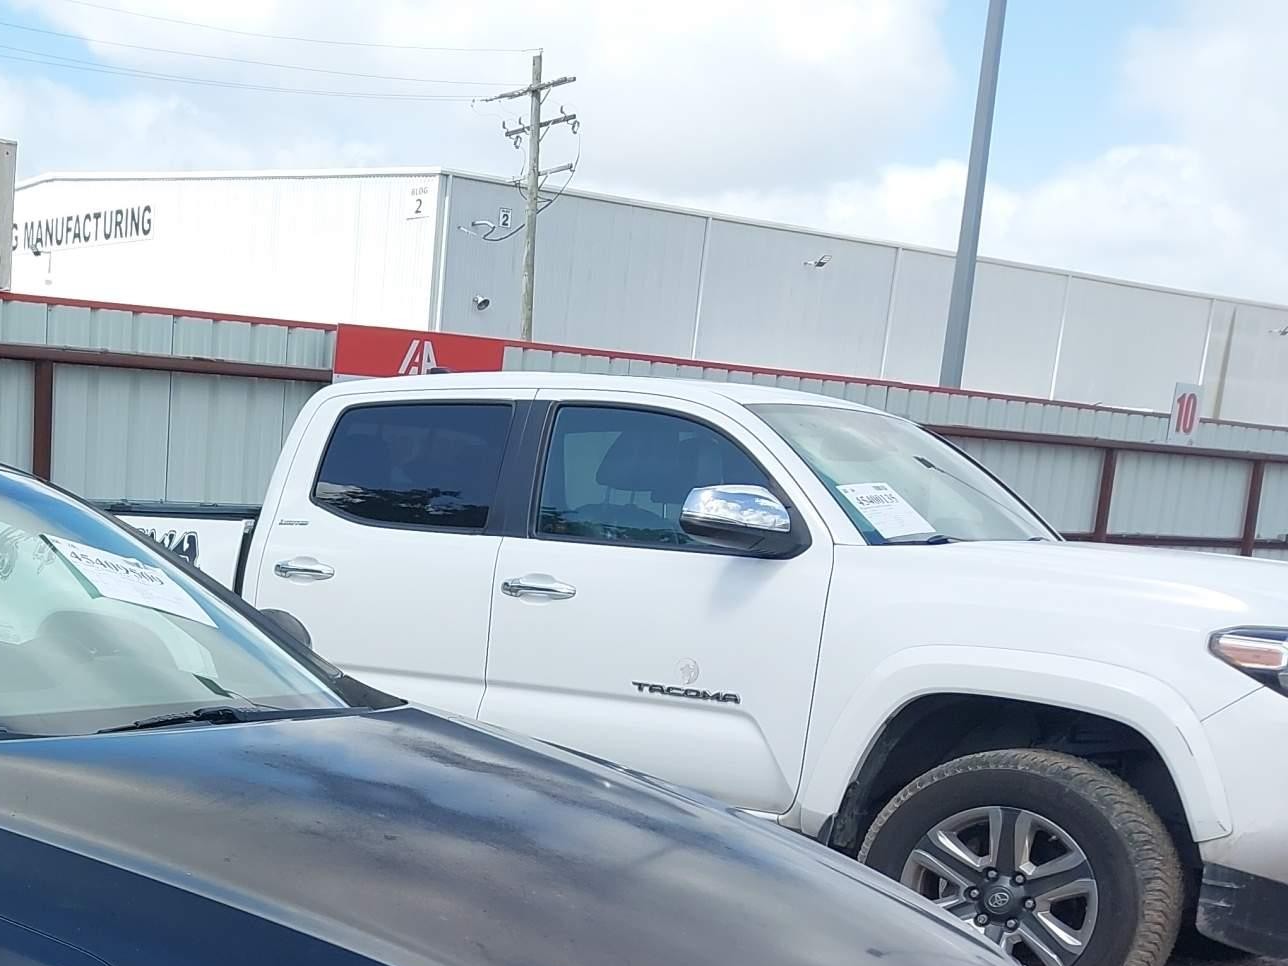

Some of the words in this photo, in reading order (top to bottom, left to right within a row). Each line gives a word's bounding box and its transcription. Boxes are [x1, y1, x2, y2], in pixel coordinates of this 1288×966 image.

[414, 198, 423, 214] 2
[23, 204, 152, 251] MANUFACTURING
[502, 213, 509, 226] 2
[1175, 393, 1197, 435] 10
[631, 680, 741, 705] TACOMA
